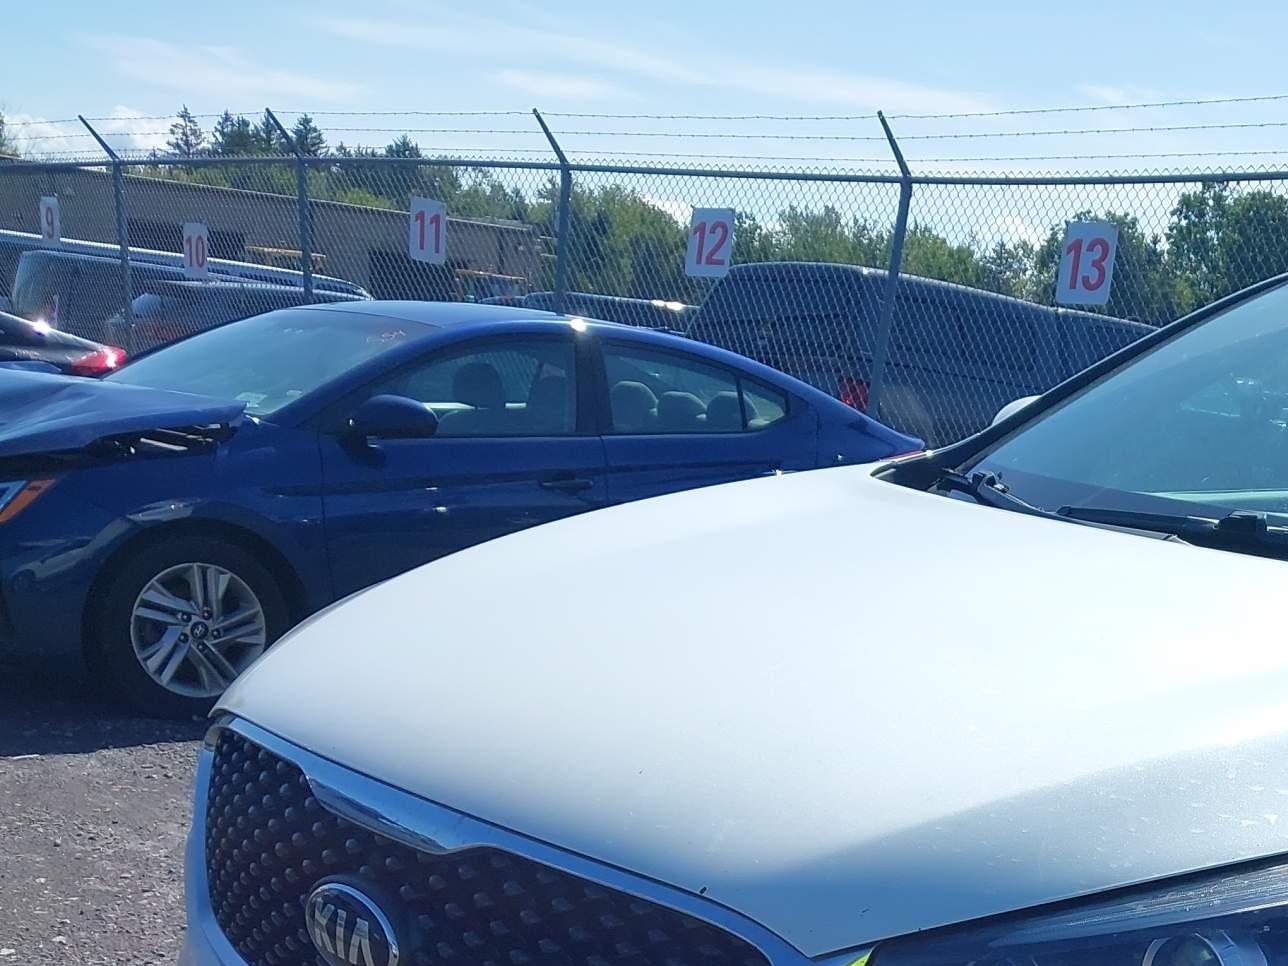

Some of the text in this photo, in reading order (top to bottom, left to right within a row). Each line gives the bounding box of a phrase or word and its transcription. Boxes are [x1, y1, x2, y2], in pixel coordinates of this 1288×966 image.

[46, 206, 54, 240] 9
[415, 210, 440, 254] 11
[693, 221, 728, 266] 12
[185, 235, 205, 267] 10
[1066, 238, 1110, 291] 13
